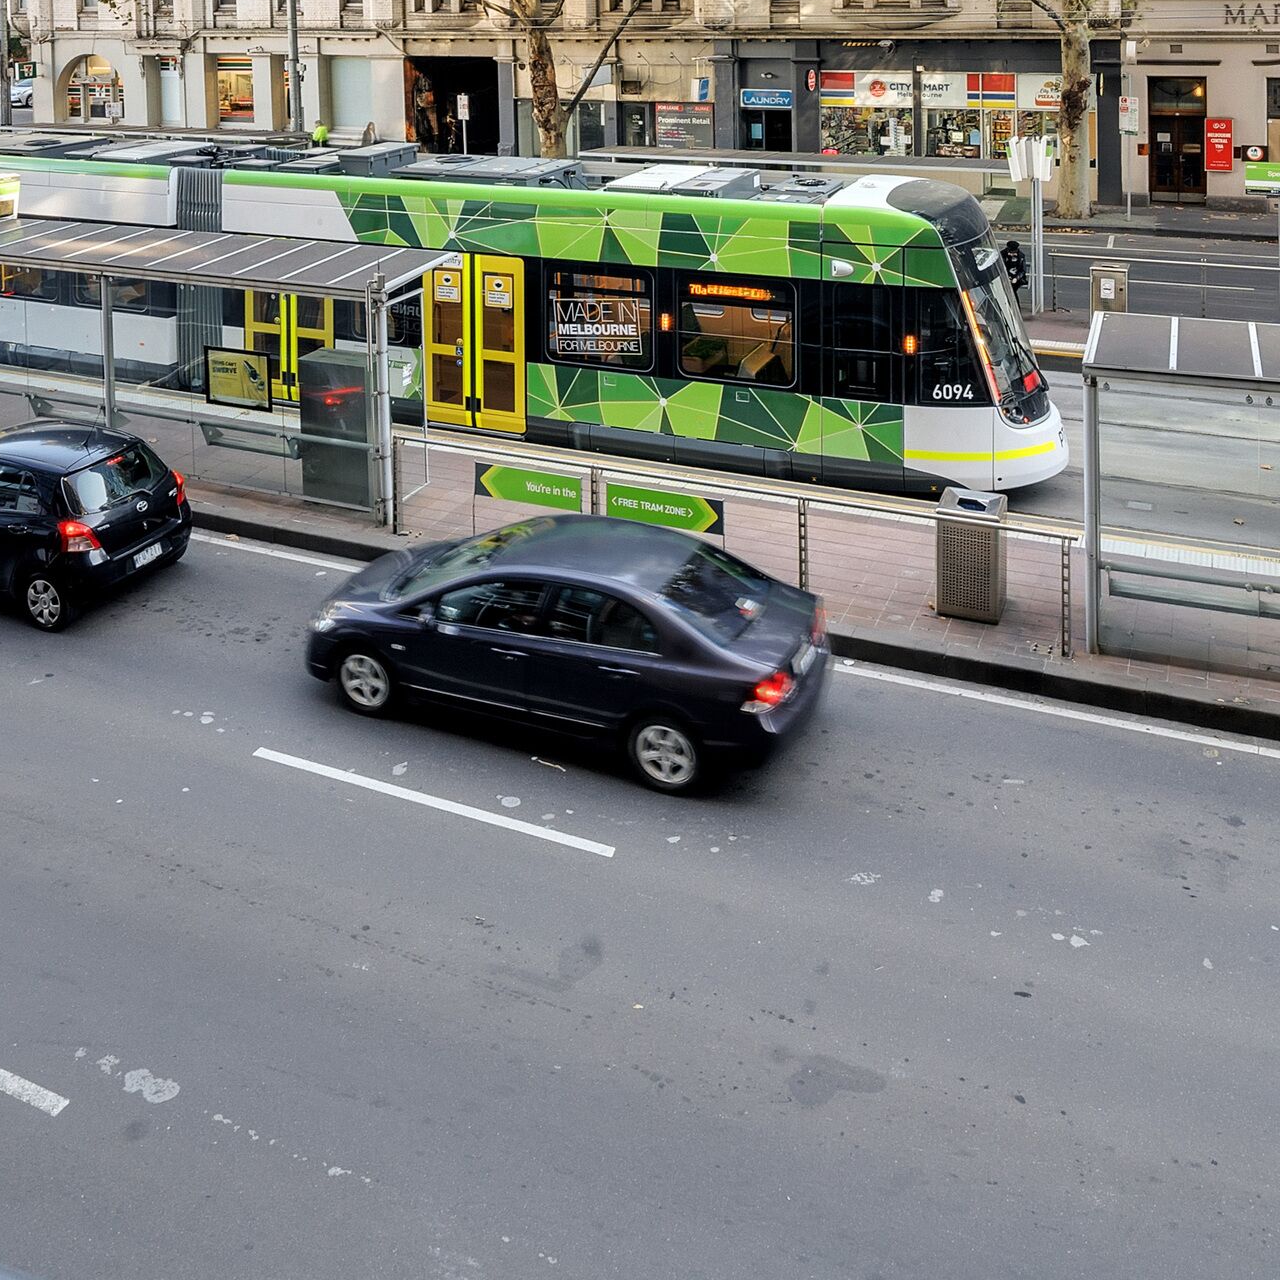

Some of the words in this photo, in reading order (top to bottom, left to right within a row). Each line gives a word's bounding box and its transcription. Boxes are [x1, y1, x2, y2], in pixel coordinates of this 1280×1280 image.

[889, 83, 912, 91] CITY
[923, 83, 950, 91] MART
[744, 96, 790, 104] LAUNDRY
[658, 116, 691, 124] Prominent
[692, 117, 710, 125] Retail
[556, 302, 614, 322] MADE
[618, 302, 637, 323] IN
[558, 323, 638, 336] MELBOURNE
[559, 340, 579, 351] FOR
[580, 341, 639, 352] MELBOURNE
[932, 384, 974, 400] 6094
[525, 481, 551, 495] You're
[552, 487, 560, 496] in
[562, 488, 577, 499] the
[618, 498, 638, 509] FREE
[640, 501, 664, 513] TRAM
[664, 504, 687, 516] ZONE
